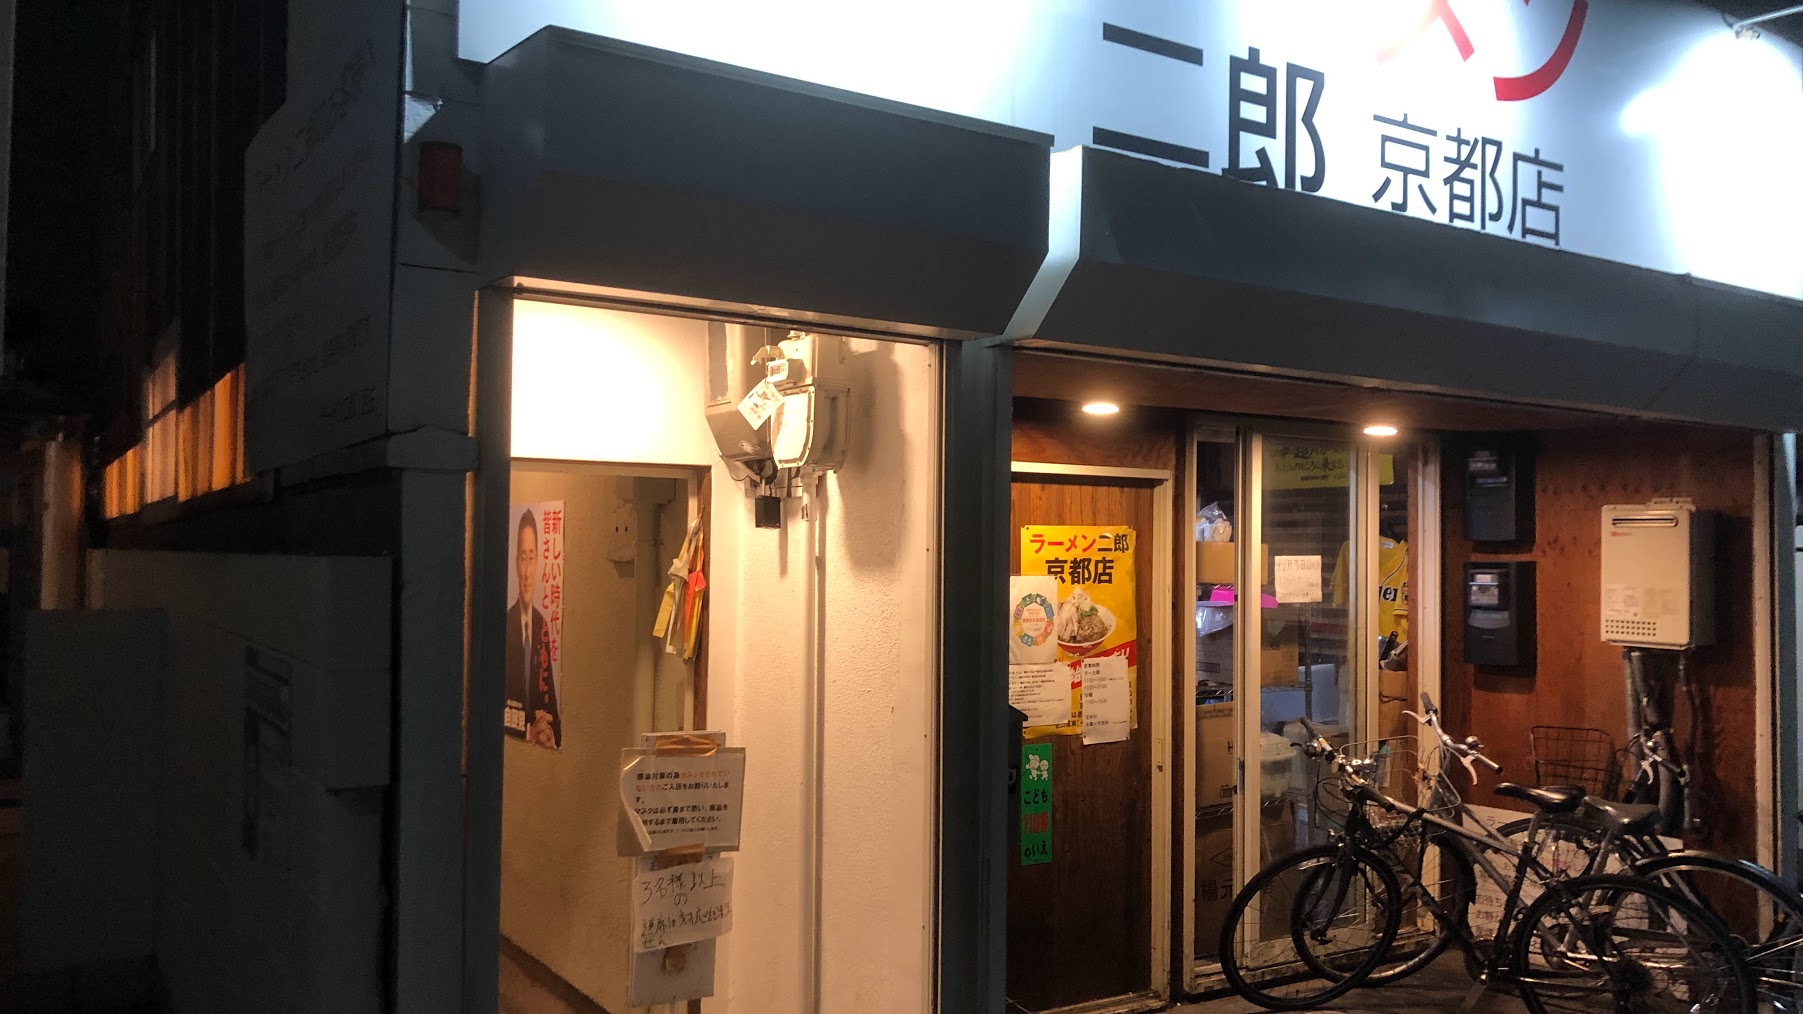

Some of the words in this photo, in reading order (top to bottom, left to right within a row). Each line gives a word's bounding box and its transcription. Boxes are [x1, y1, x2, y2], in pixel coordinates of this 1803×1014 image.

[1093, 22, 1325, 193] 二郎
[1372, 113, 1565, 246] 京都店
[1029, 533, 1130, 554] ラーメン二郎
[1045, 556, 1114, 585] 京都店
[550, 510, 562, 662] 新しい時代を
[1024, 788, 1048, 805] こども
[673, 892, 688, 906] の
